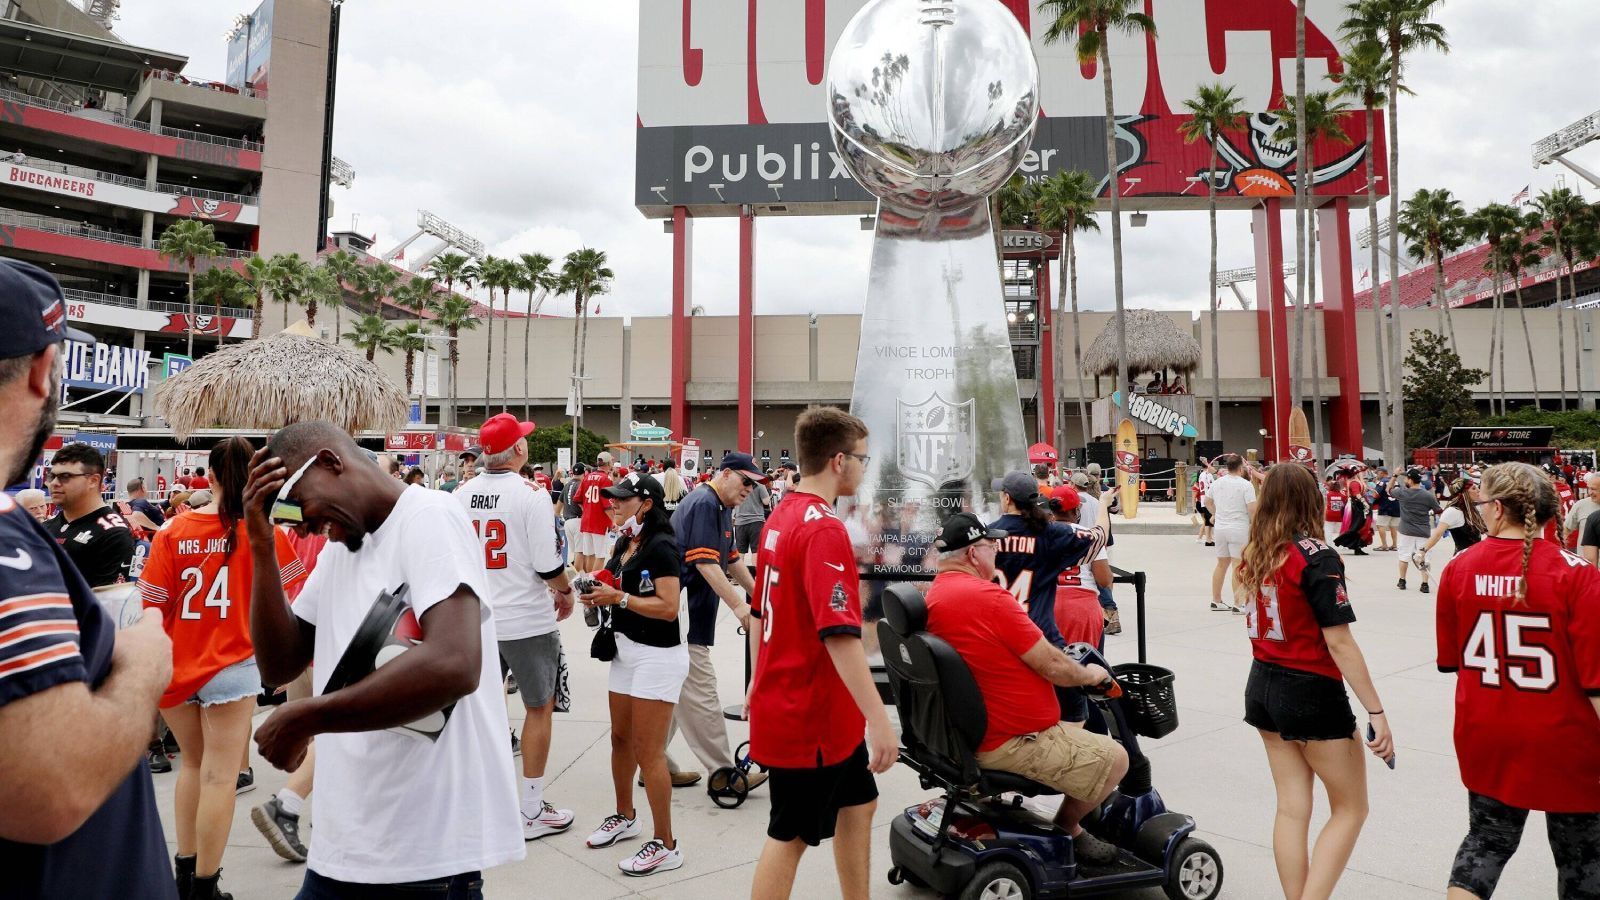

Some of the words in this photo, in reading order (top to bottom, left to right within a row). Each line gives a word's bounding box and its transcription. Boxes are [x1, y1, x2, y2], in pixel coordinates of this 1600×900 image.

[684, 142, 851, 182] Publix
[10, 167, 94, 196] BUCCANEERS
[1003, 235, 1042, 247] KETS
[1565, 261, 1590, 275] GAZER
[875, 346, 917, 358] VINCE
[94, 342, 151, 389] BANK
[905, 368, 957, 379] TROPH
[1471, 431, 1491, 440] TEAM
[1507, 430, 1531, 439] STORE
[585, 485, 599, 503] 40
[471, 494, 500, 509] BRADY
[933, 497, 969, 508] BOWL
[97, 513, 128, 530] 12
[868, 534, 898, 543] TAMPA
[900, 534, 918, 543] BAY
[921, 535, 937, 543] BU
[178, 538, 231, 554] MRS.JUIC
[867, 547, 906, 556] KANS
[908, 547, 930, 556] CITY
[873, 564, 921, 573] RAYMOND
[180, 565, 231, 619] 24
[1463, 610, 1558, 691] 45
